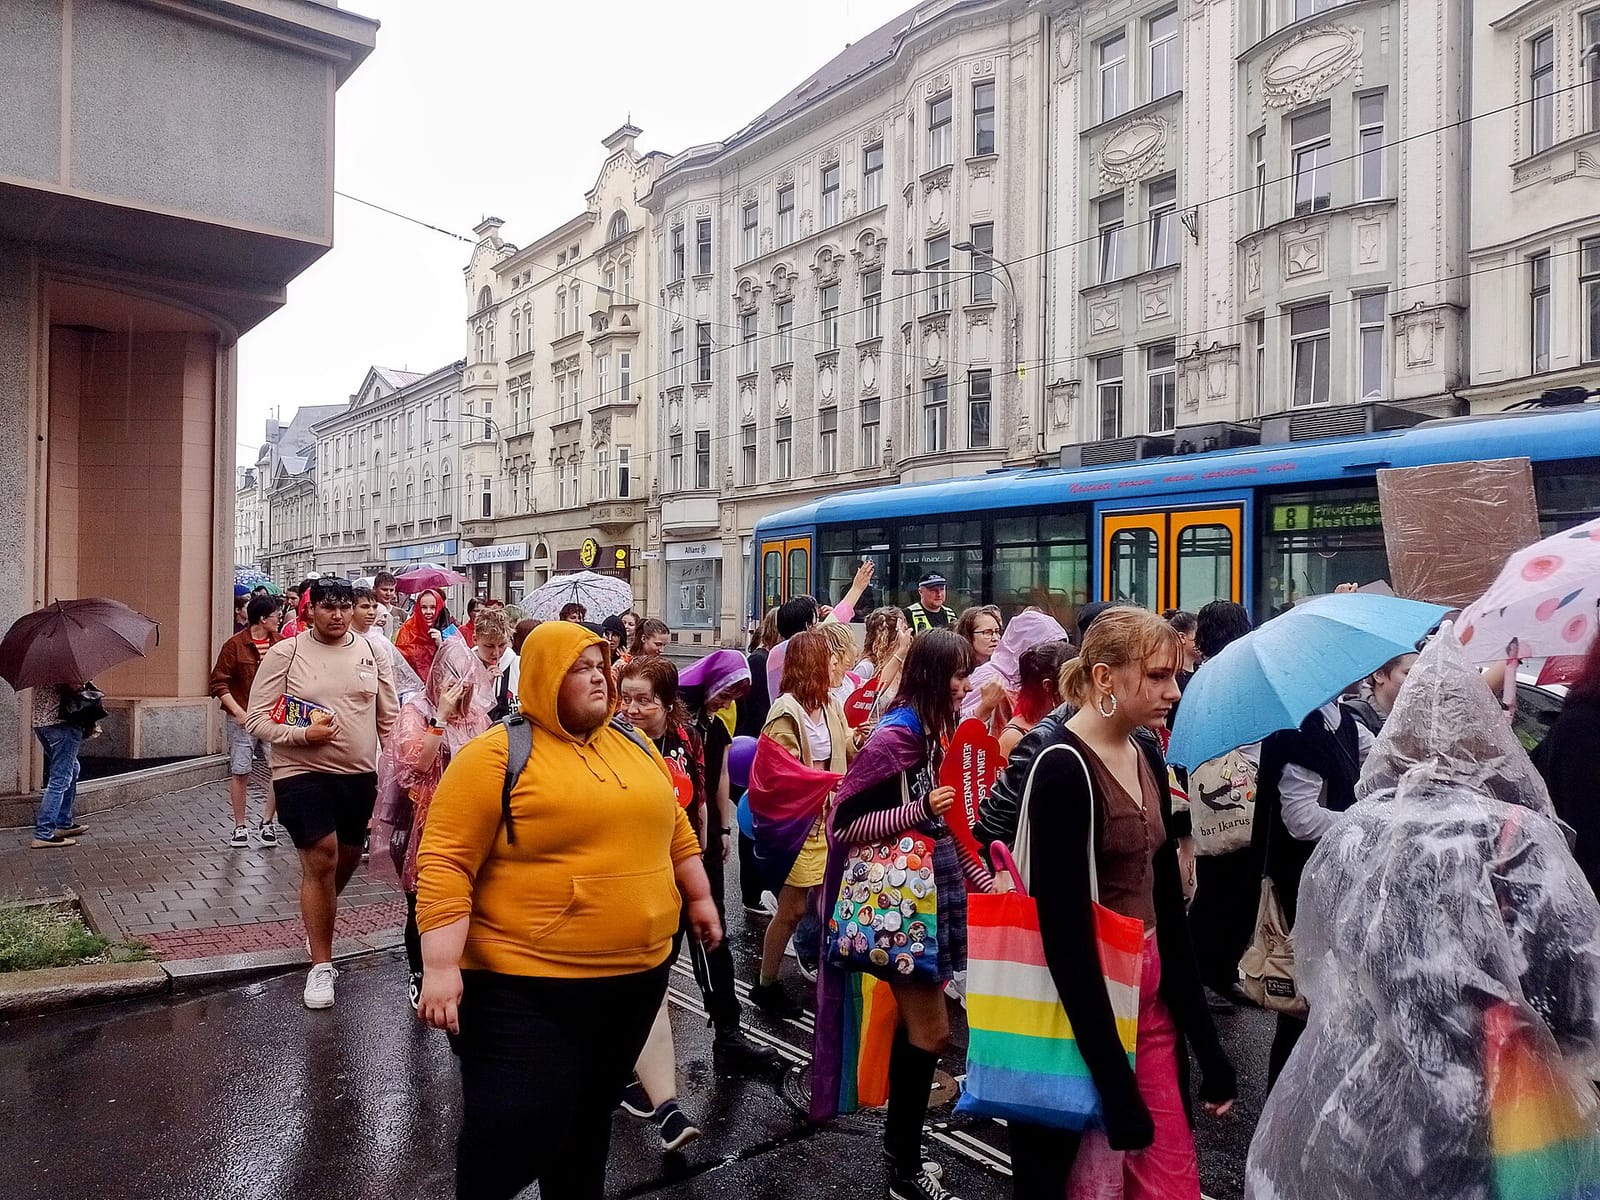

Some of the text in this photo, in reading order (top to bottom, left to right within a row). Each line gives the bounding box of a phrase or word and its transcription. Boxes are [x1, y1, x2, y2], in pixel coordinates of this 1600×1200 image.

[1286, 508, 1296, 528] 8
[685, 546, 700, 554] Allianz
[962, 742, 972, 770] JEDNO
[977, 748, 986, 777] JEDNA
[1200, 818, 1250, 837] bar Ikarus
